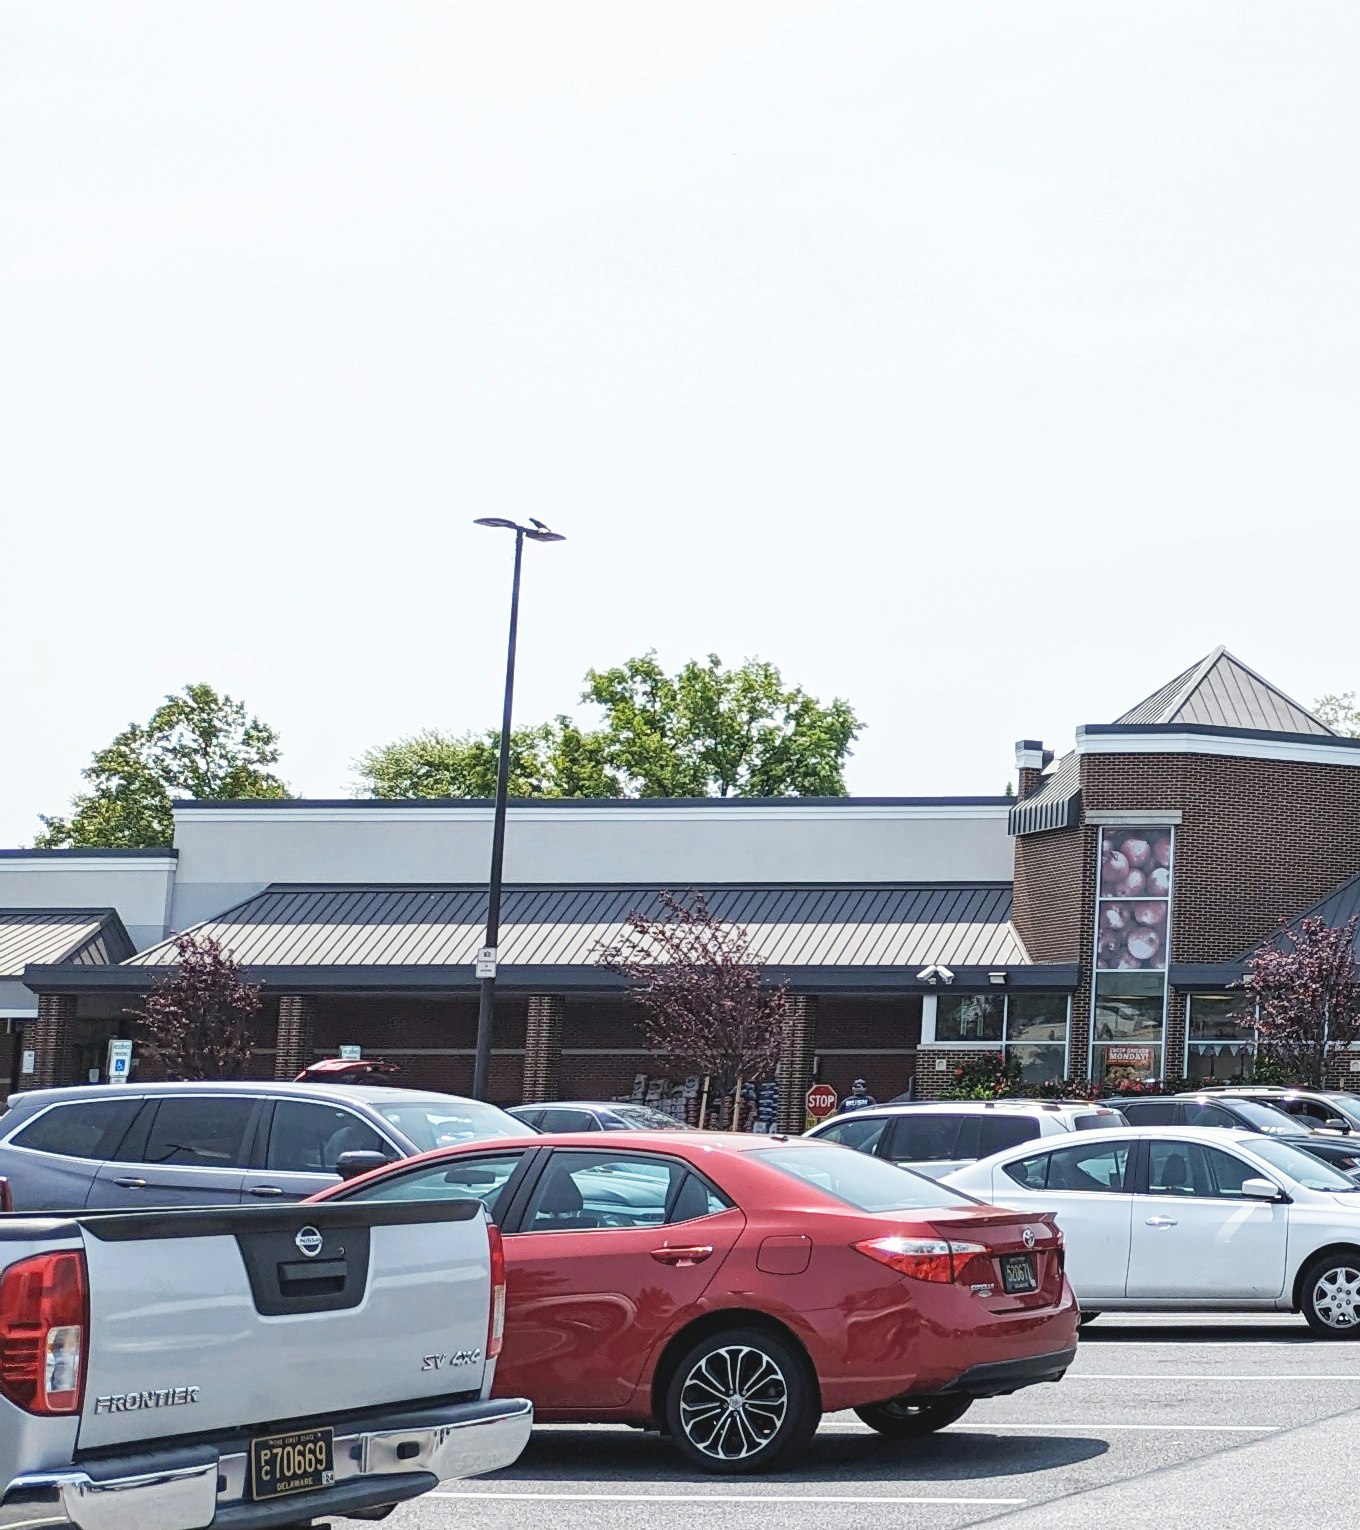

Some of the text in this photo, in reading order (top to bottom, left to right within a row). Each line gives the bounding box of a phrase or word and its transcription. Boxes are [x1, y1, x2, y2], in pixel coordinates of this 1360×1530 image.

[808, 1095, 834, 1108] STOP
[422, 1354, 447, 1371] SV
[95, 1386, 200, 1415] FRONTIER
[272, 1441, 326, 1478] 70669
[277, 1477, 313, 1491] DELAWARE
